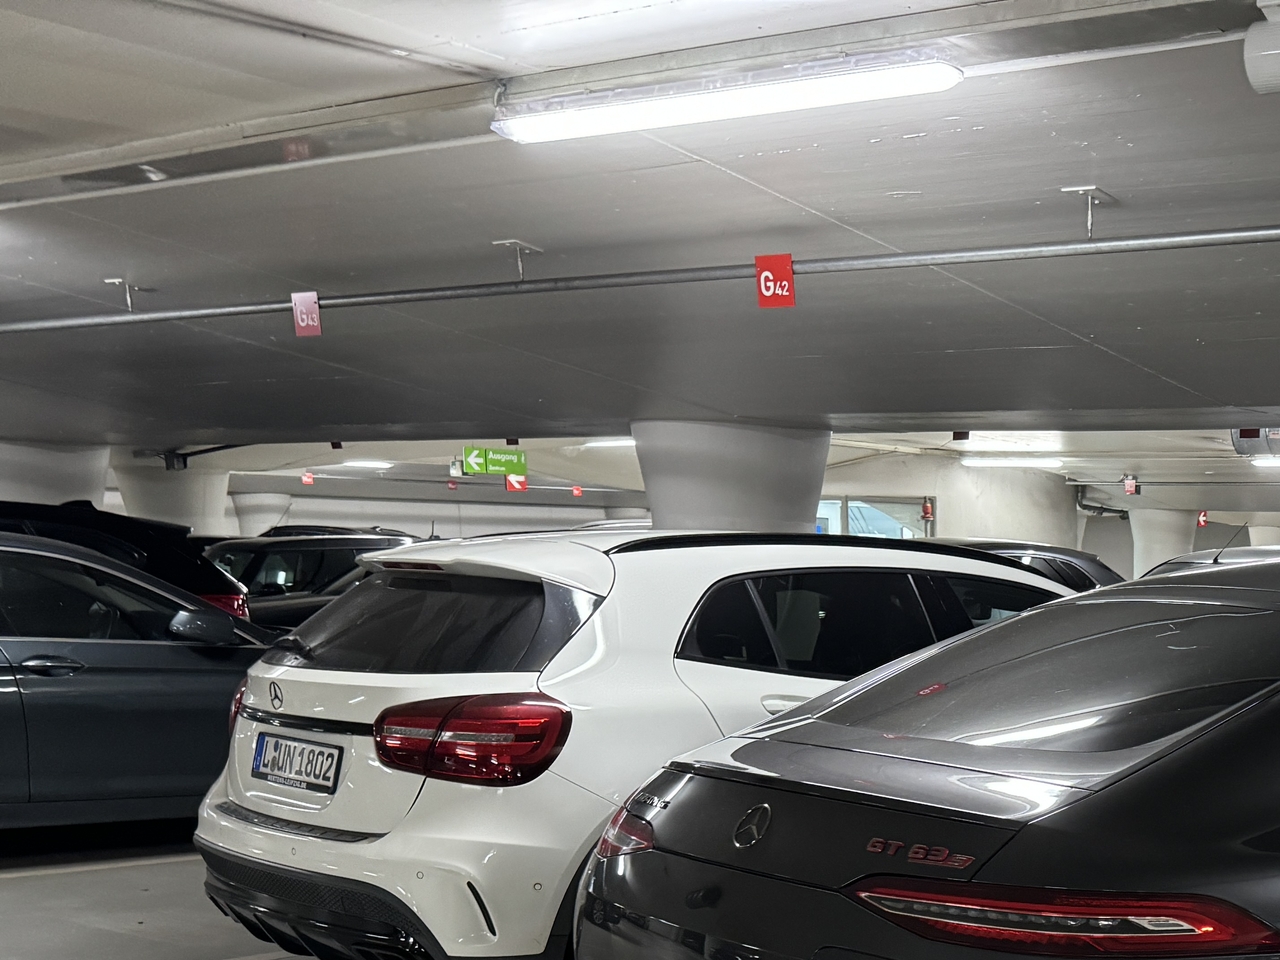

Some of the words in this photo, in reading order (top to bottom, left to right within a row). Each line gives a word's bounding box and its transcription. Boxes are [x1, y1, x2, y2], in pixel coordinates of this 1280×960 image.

[760, 270, 790, 297] G42
[297, 306, 318, 327] G43
[488, 450, 518, 463] Ausgang
[262, 741, 270, 768] L
[277, 742, 297, 775] UN
[294, 747, 335, 782] 1802
[866, 837, 905, 856] GT
